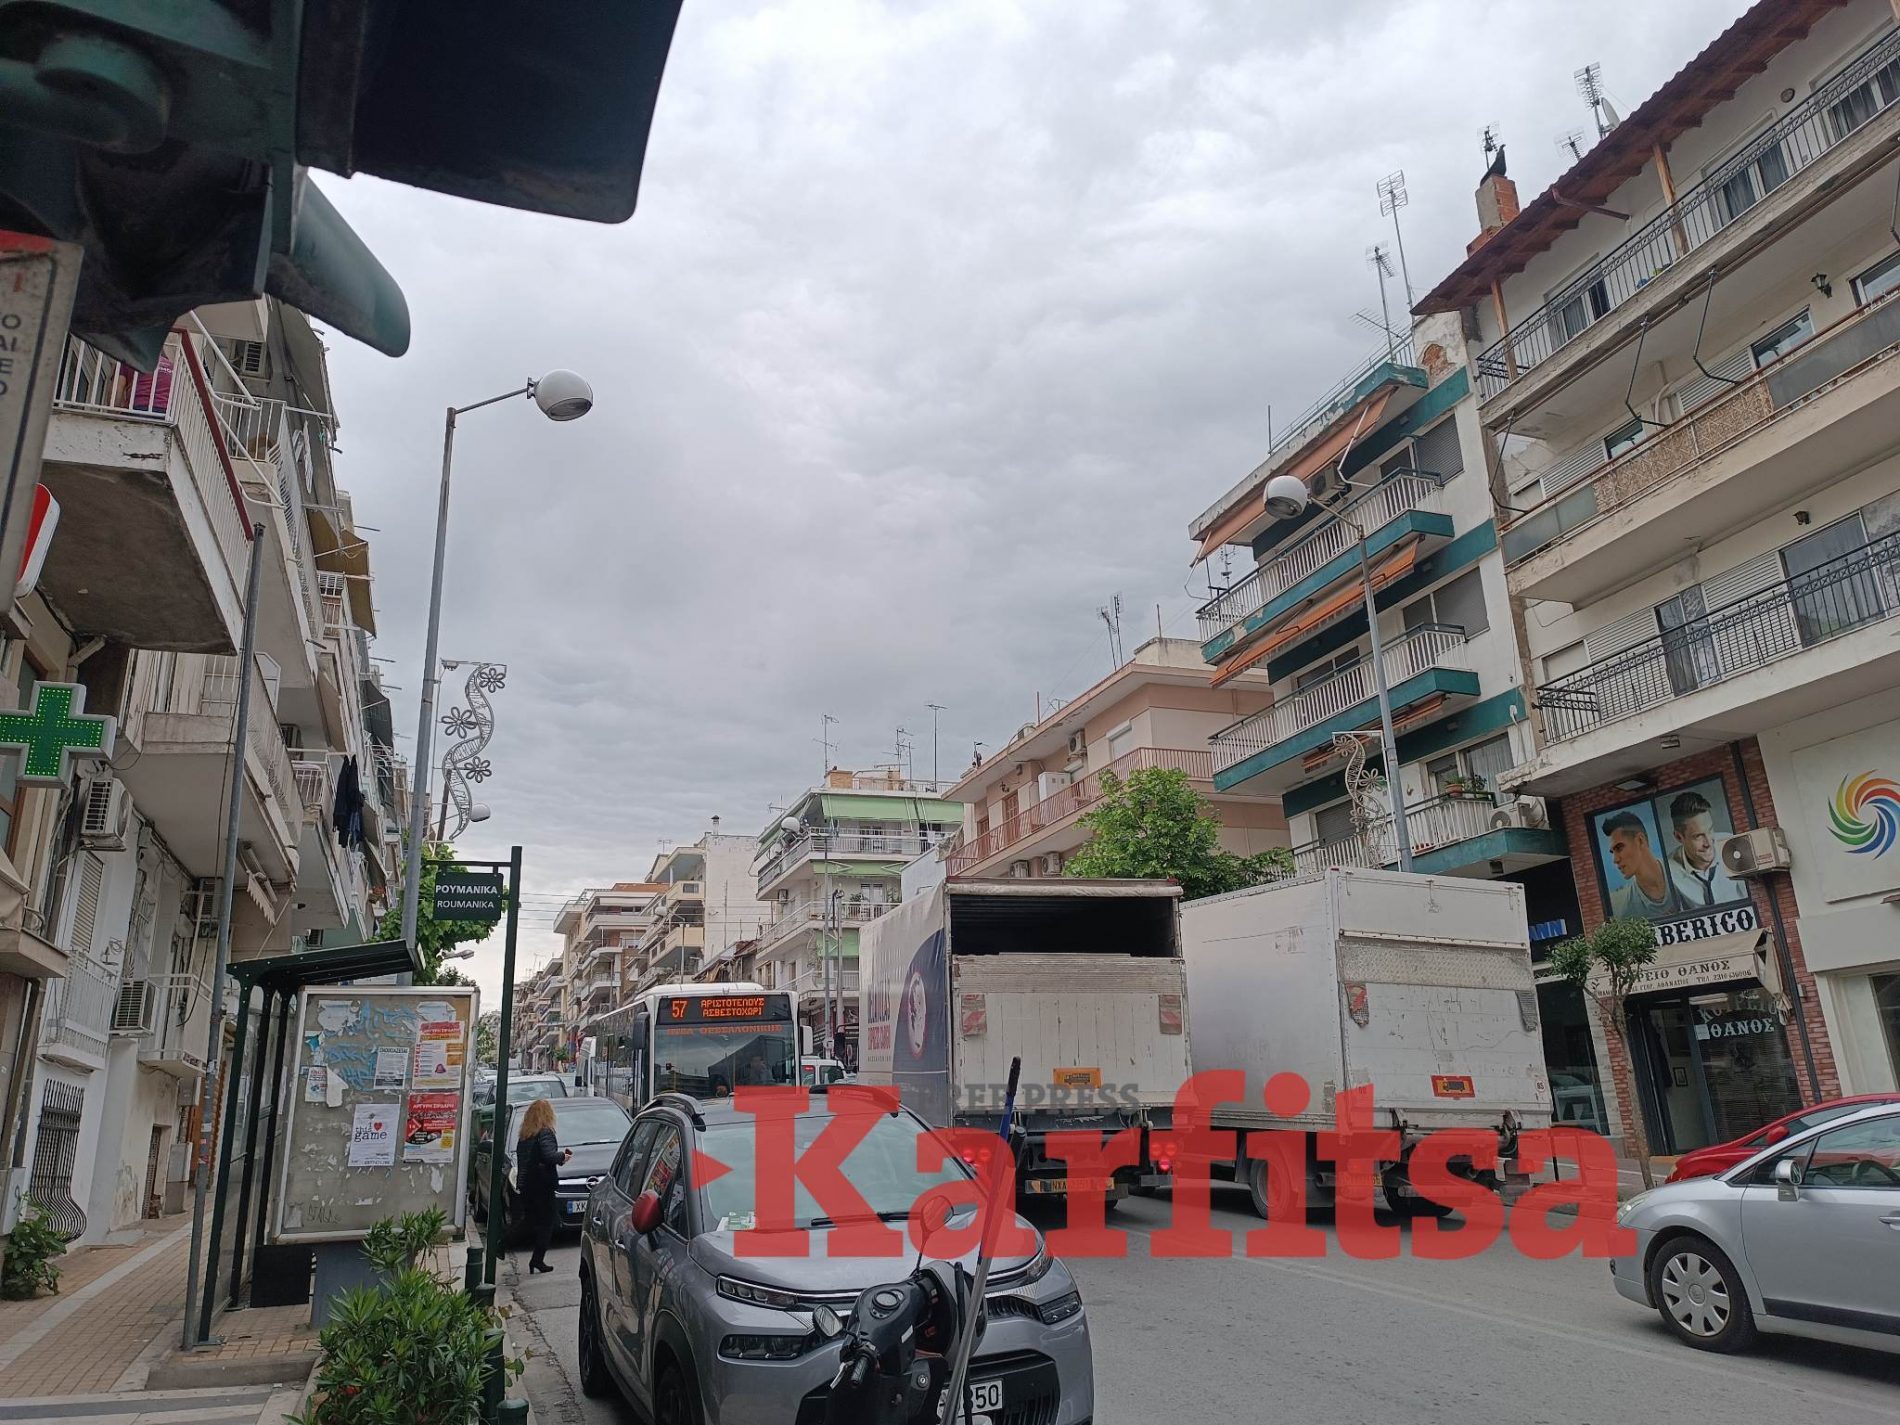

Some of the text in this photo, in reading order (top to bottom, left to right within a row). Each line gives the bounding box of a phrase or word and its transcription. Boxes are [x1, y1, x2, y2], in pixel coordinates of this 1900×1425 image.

[435, 884, 498, 895] ΡΟΥΜΑΝΙΚΑ
[437, 900, 495, 909] ROUMANIKA
[1678, 959, 1731, 977] ΘΑΝΟΣ
[671, 1000, 688, 1018] 57
[702, 1007, 763, 1018] ΑΣΒΕΣΤΟΧΩΡΙ
[1710, 1017, 1775, 1038] ΘΑΝΟΣ
[354, 1131, 388, 1143] game
[975, 1384, 999, 1409] 50
